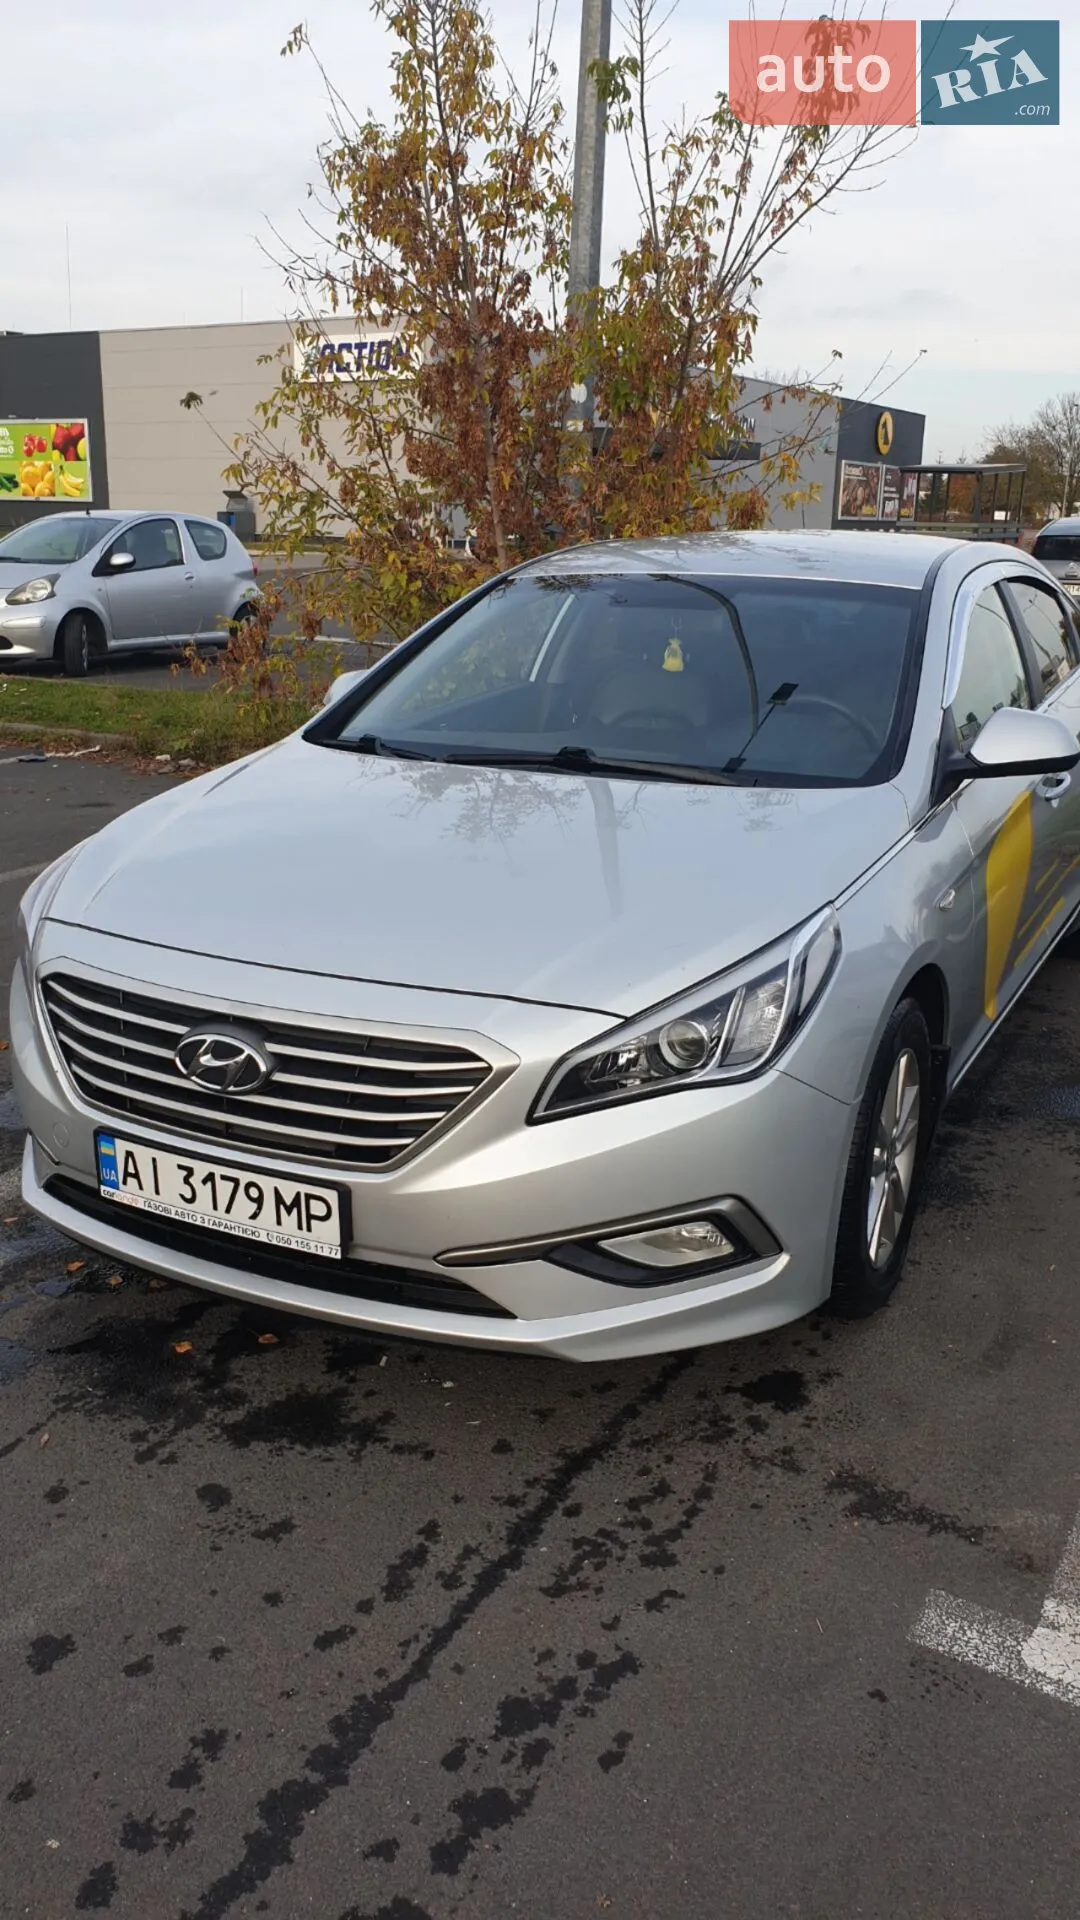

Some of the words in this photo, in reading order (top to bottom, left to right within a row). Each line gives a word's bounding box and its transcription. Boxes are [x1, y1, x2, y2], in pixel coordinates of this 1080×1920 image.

[102, 1167, 117, 1183] UA
[122, 1150, 160, 1196] AI
[177, 1163, 264, 1221] 3179
[274, 1186, 333, 1233] MP
[143, 1200, 172, 1215] ГАЗОВІ
[174, 1210, 197, 1223] АВТО
[208, 1218, 261, 1239] ГАРАНТІЄЮ
[275, 1235, 292, 1246] 050
[294, 1240, 312, 1251] 155
[314, 1244, 324, 1254] 11
[328, 1247, 339, 1257] 77
